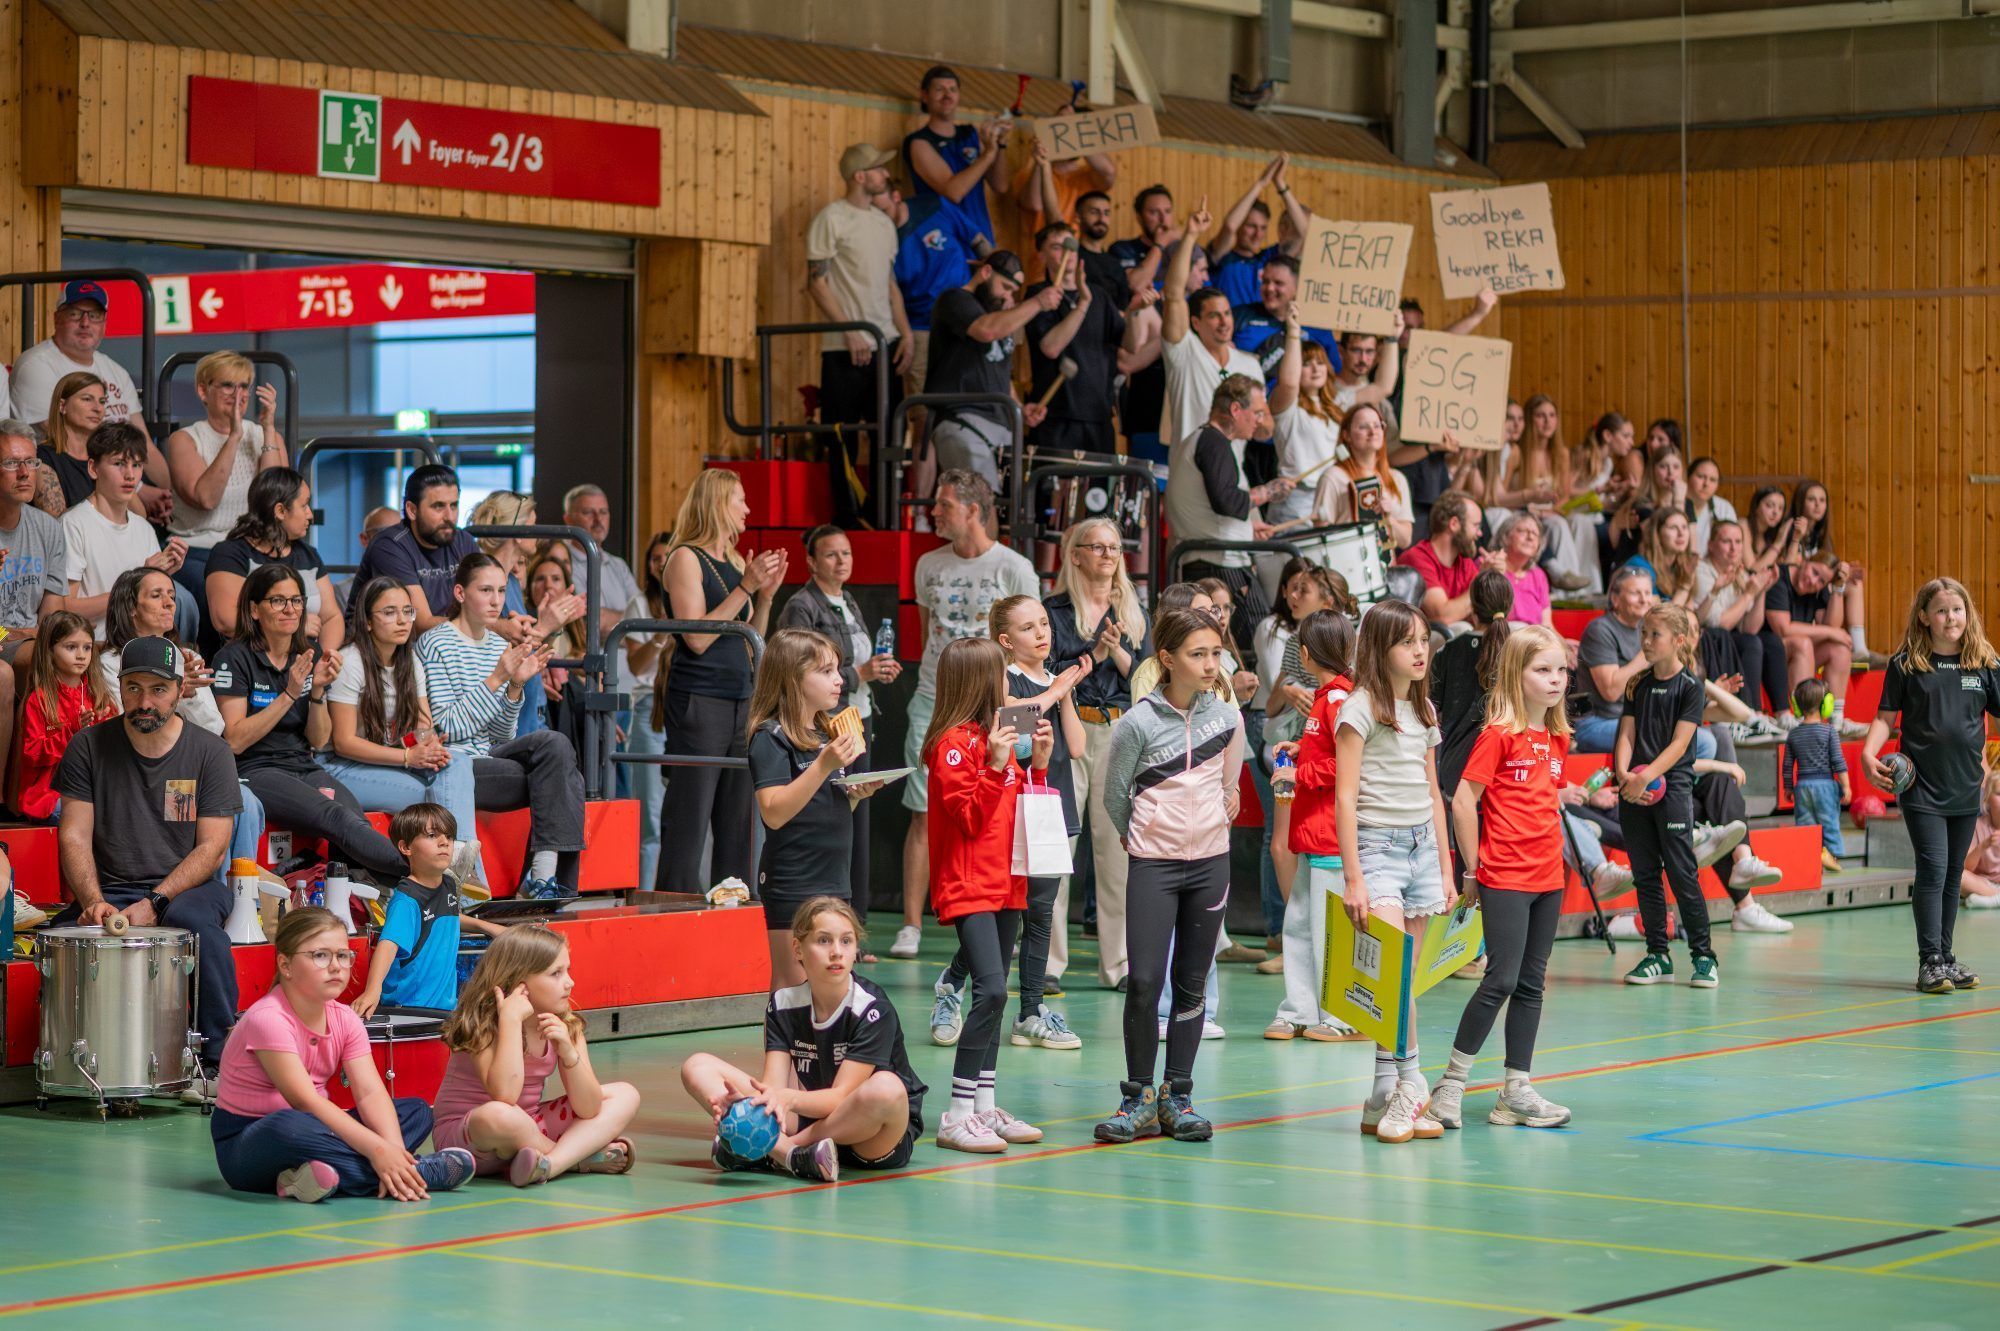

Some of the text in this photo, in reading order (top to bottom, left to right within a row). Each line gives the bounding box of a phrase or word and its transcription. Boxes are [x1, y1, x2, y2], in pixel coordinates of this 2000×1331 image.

[429, 139, 464, 168] Foyer
[490, 132, 544, 173] 2/3
[1440, 198, 1525, 229] Goodbye
[1507, 252, 1530, 274] the
[1489, 273, 1538, 291] BEST
[298, 288, 354, 319] 7-15
[1304, 279, 1396, 312] THE LEGEND
[1419, 347, 1477, 395] SG
[1415, 396, 1479, 430] RIGO
[1195, 716, 1227, 741] 1994
[270, 835, 291, 843] REIHE
[277, 847, 284, 859] 2
[795, 1040, 817, 1050] Kempa
[797, 1058, 811, 1073] MT
